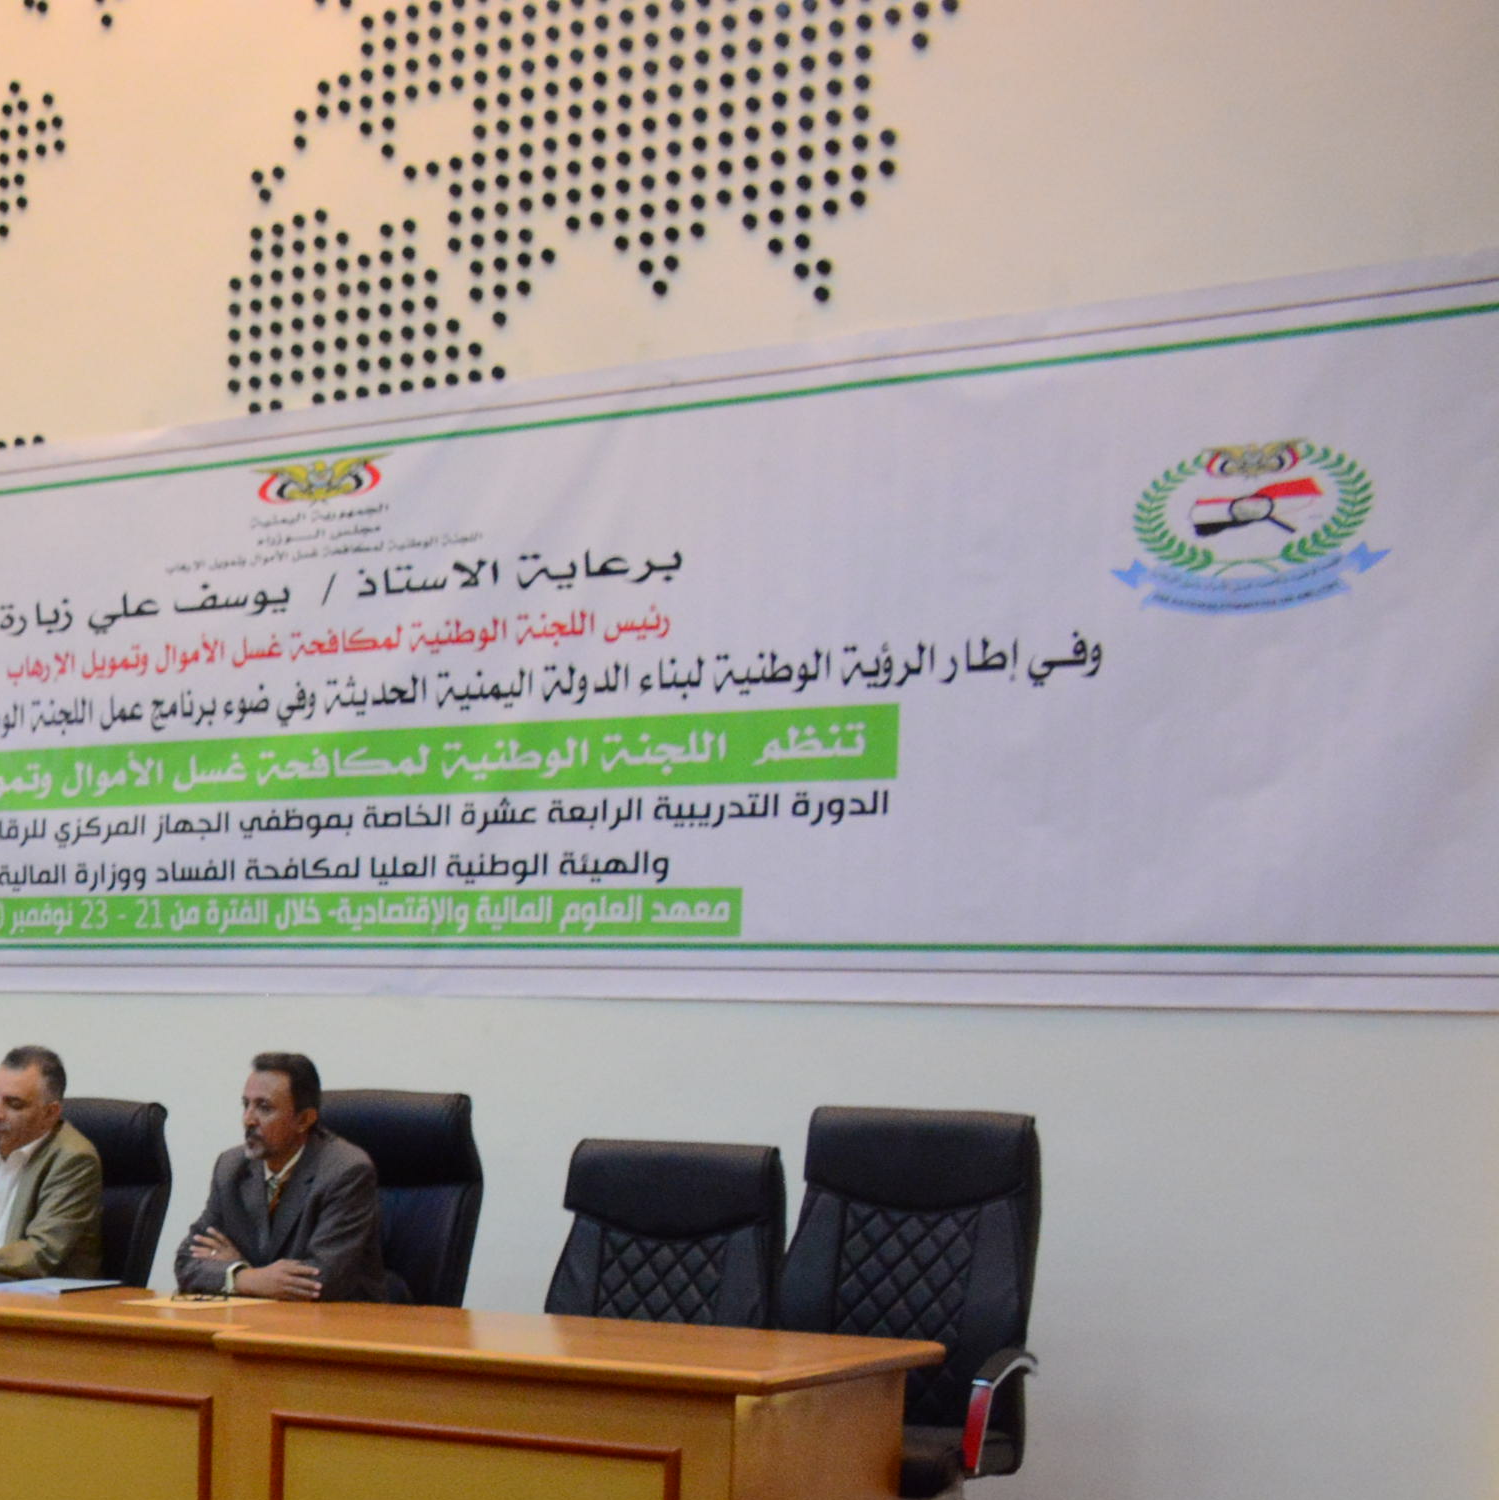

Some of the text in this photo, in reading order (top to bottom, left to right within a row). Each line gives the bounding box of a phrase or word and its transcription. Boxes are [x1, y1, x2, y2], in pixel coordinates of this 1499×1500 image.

[356, 555, 499, 597] الاستاذ
[517, 549, 683, 590] برعاية
[174, 582, 291, 616] يوسف
[320, 572, 337, 605] /
[87, 591, 159, 634] علي
[515, 609, 596, 645] اللجنة
[603, 604, 671, 642] رئيس
[231, 635, 281, 668] غسل
[290, 625, 403, 662] لمكافحة
[409, 616, 508, 653] الوطنية
[80, 644, 148, 681] وتمويل
[154, 632, 224, 675] الأموال
[714, 647, 831, 696] الوطنية
[841, 640, 935, 688] الرؤية
[941, 636, 1019, 685] إطار
[1026, 630, 1102, 687] وفي
[325, 674, 427, 710] الحديثة
[436, 669, 533, 709] اليمنية
[543, 661, 629, 705] الدولة
[640, 657, 704, 699] لبناء
[30, 697, 94, 734] اللجنة
[100, 693, 144, 733] عمل
[150, 688, 217, 733] برنامج
[223, 683, 270, 722] ضوء
[276, 680, 317, 727] وفي
[440, 735, 590, 782] الوطنية
[601, 729, 728, 775] اللجنة
[752, 721, 867, 766] تنظم
[60, 750, 164, 798] الأموال
[172, 752, 248, 792] غسل
[255, 744, 431, 787] لمكافحة
[238, 807, 354, 840] بموظفي
[362, 803, 451, 831] الخاصة
[460, 798, 537, 834] عشرة
[547, 796, 643, 831] الرابعة
[652, 792, 780, 829] التدريبية
[790, 789, 890, 826] الدورة
[54, 814, 146, 849] المركزي
[153, 811, 230, 844] الجهاز
[75, 862, 147, 892] ووزارة
[155, 858, 235, 884] الفساد
[244, 856, 361, 881] لمكافحة
[369, 855, 436, 887] العليا
[445, 852, 548, 885] الوطنية
[558, 850, 670, 883] والهيئة
[8, 901, 74, 937] نوفمبر
[79, 899, 109, 930] 23
[135, 899, 163, 930] 21
[170, 900, 200, 931] من
[207, 898, 268, 933] الفترة
[275, 898, 321, 931] خلال
[475, 895, 553, 931] المالية
[558, 894, 643, 933] العلوم
[650, 896, 731, 924] معهد
